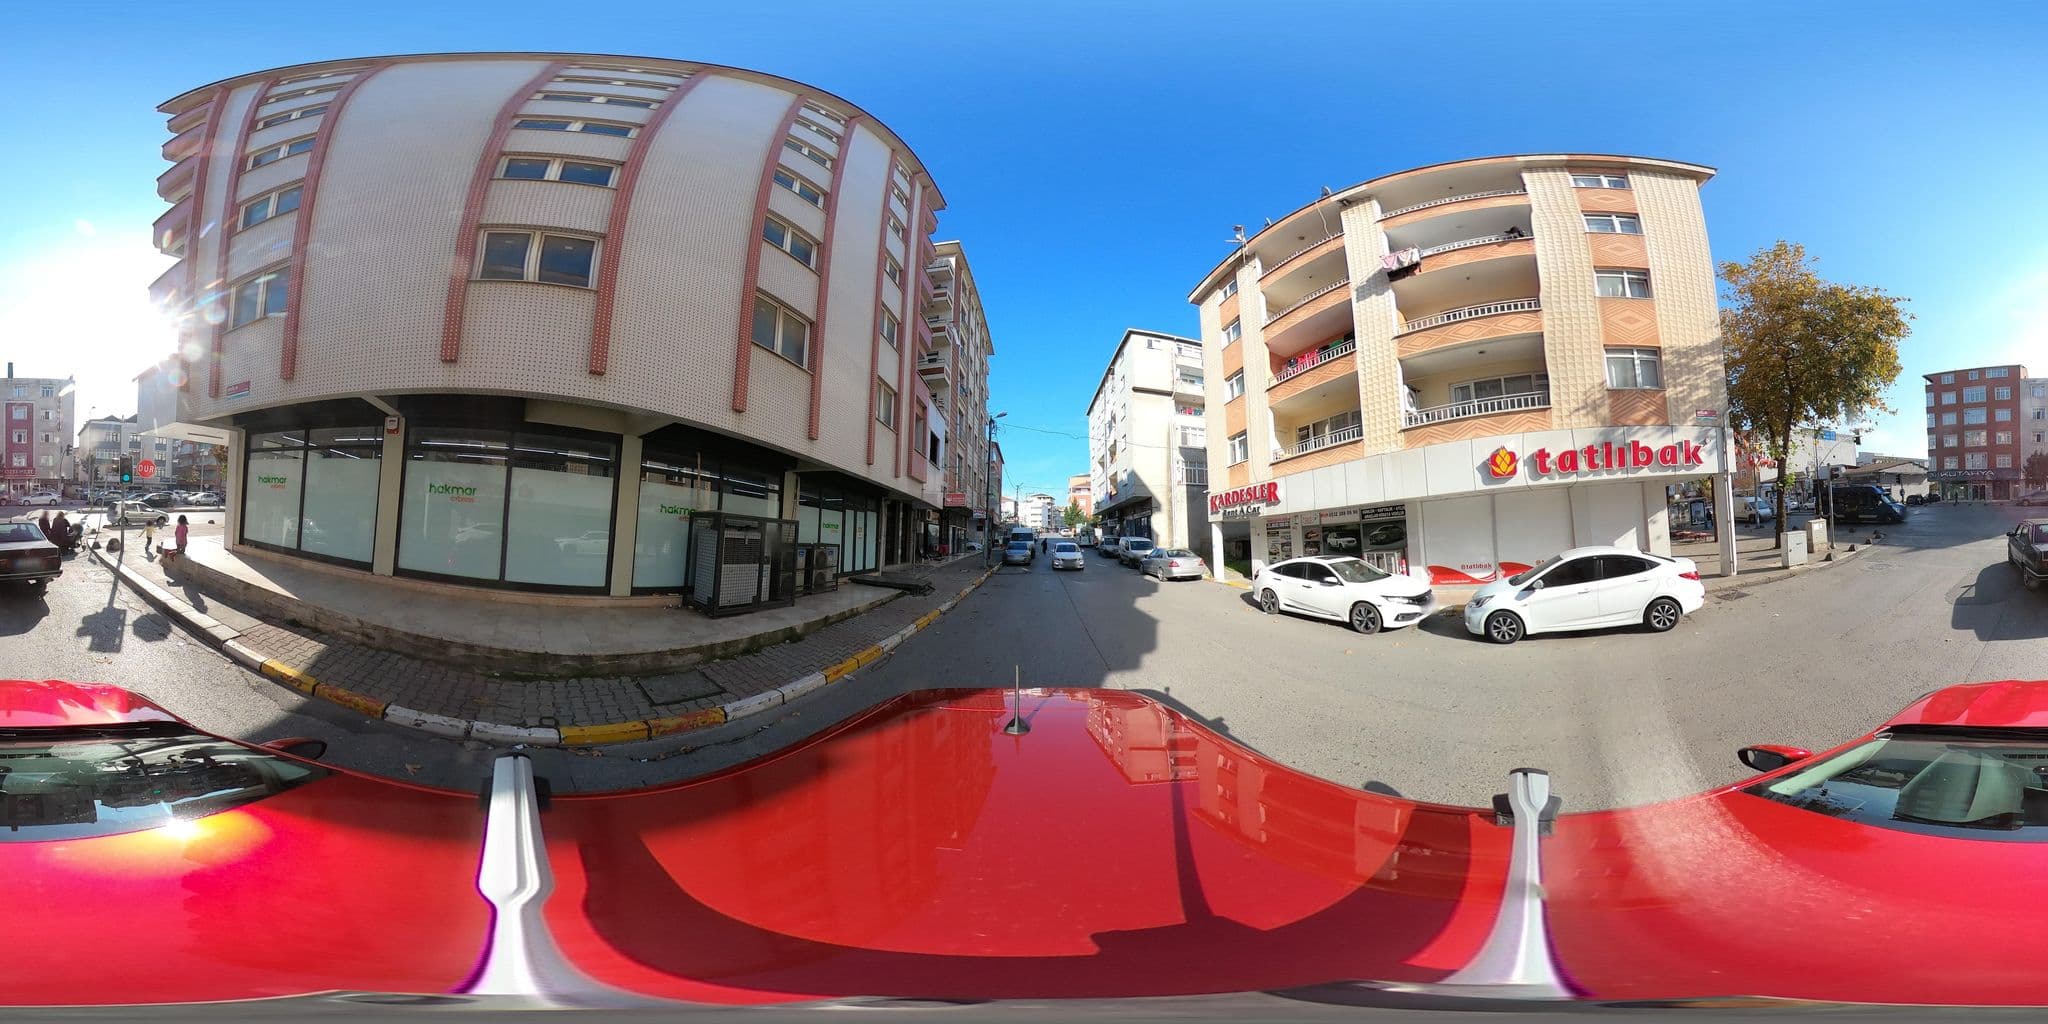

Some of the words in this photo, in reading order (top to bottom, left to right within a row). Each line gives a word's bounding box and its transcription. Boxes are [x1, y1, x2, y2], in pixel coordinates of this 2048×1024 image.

[1535, 439, 1704, 475] tatlıbak
[138, 464, 155, 473] DUR
[257, 475, 288, 484] hakmar
[428, 482, 478, 497] hakmar
[1223, 508, 1239, 517] Rent
[1239, 506, 1245, 515] A
[1246, 505, 1261, 514] Car
